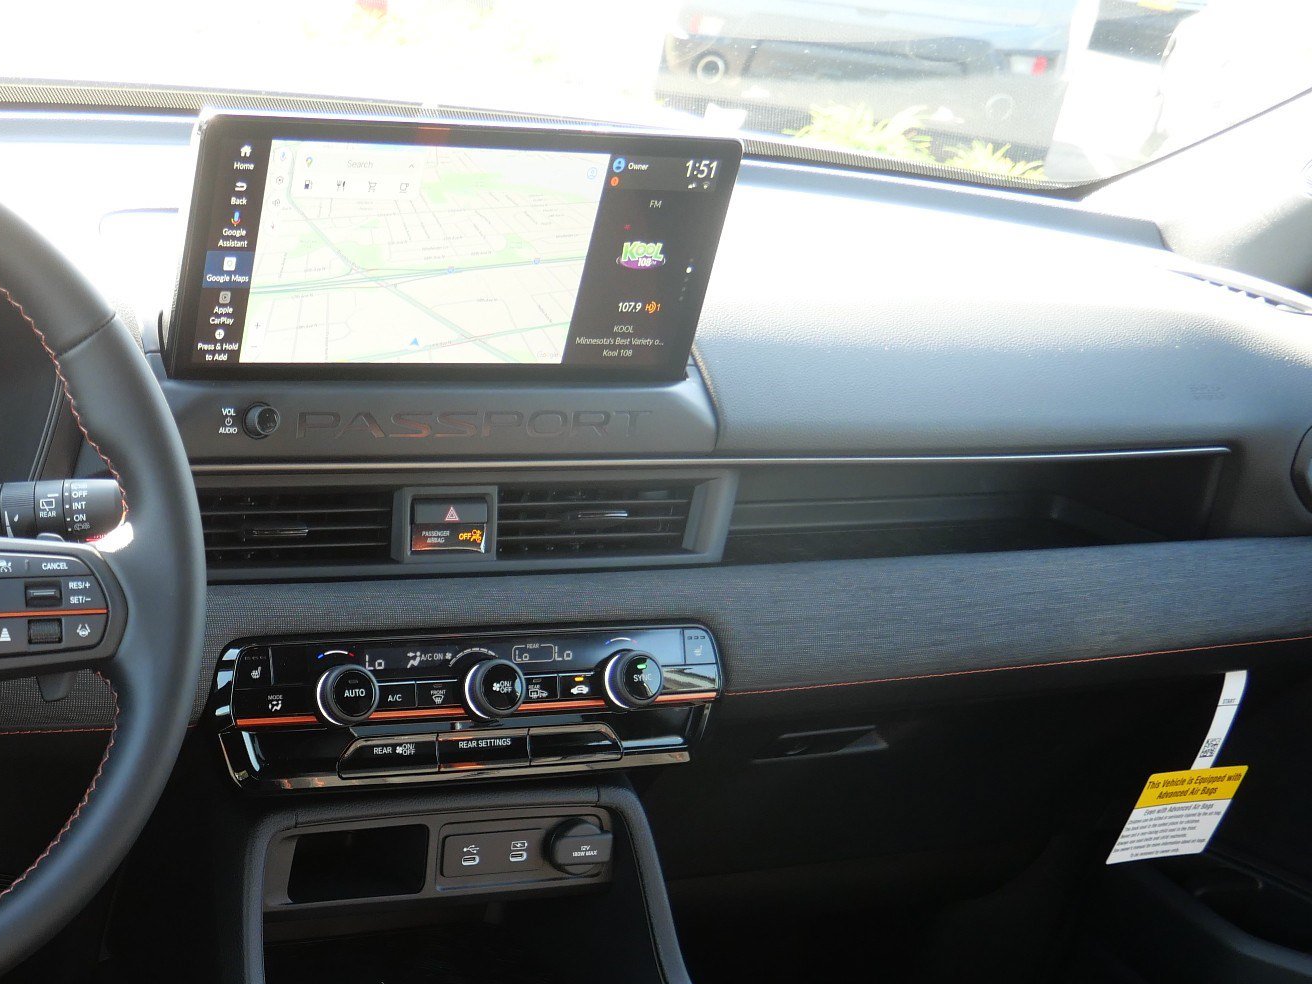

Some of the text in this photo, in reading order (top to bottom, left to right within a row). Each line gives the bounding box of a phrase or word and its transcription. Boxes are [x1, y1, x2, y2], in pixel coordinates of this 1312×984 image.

[234, 162, 254, 170] Home
[347, 160, 373, 169] Search
[628, 162, 648, 171] Owner
[686, 160, 718, 179] 1:51
[231, 197, 247, 205] Back
[649, 200, 662, 208] FM
[223, 229, 246, 237] Google
[218, 240, 247, 248] Assistant
[621, 241, 664, 262] KOOL
[638, 257, 652, 267] 108
[206, 275, 249, 283] Google Maps
[213, 306, 233, 314] Apple
[618, 302, 642, 312] 107.9
[209, 317, 234, 325] CarPlay
[613, 325, 634, 333] KOOL
[575, 336, 614, 345] Minnesota's
[615, 337, 630, 345] Best
[631, 337, 653, 347] Variety
[197, 343, 239, 351] Press & Hold
[206, 353, 228, 361] to Add
[603, 349, 633, 357] Kool 108
[221, 407, 236, 416] VOL
[296, 407, 653, 440] PASSPORT
[72, 490, 88, 498] OFF
[72, 501, 86, 510] INT
[73, 514, 86, 522] ON
[458, 532, 472, 540] OFF
[42, 562, 68, 570] CANCEL
[421, 652, 443, 661] A/C ON
[633, 673, 652, 682] SYNC
[344, 688, 366, 698] AUTO
[388, 694, 402, 702] A/C
[459, 738, 511, 749] REAR SETTINGS
[373, 746, 392, 755] REAR
[1147, 773, 1242, 790] This Vehicle is Equipped with
[1156, 786, 1218, 800] Advanced Air Bags
